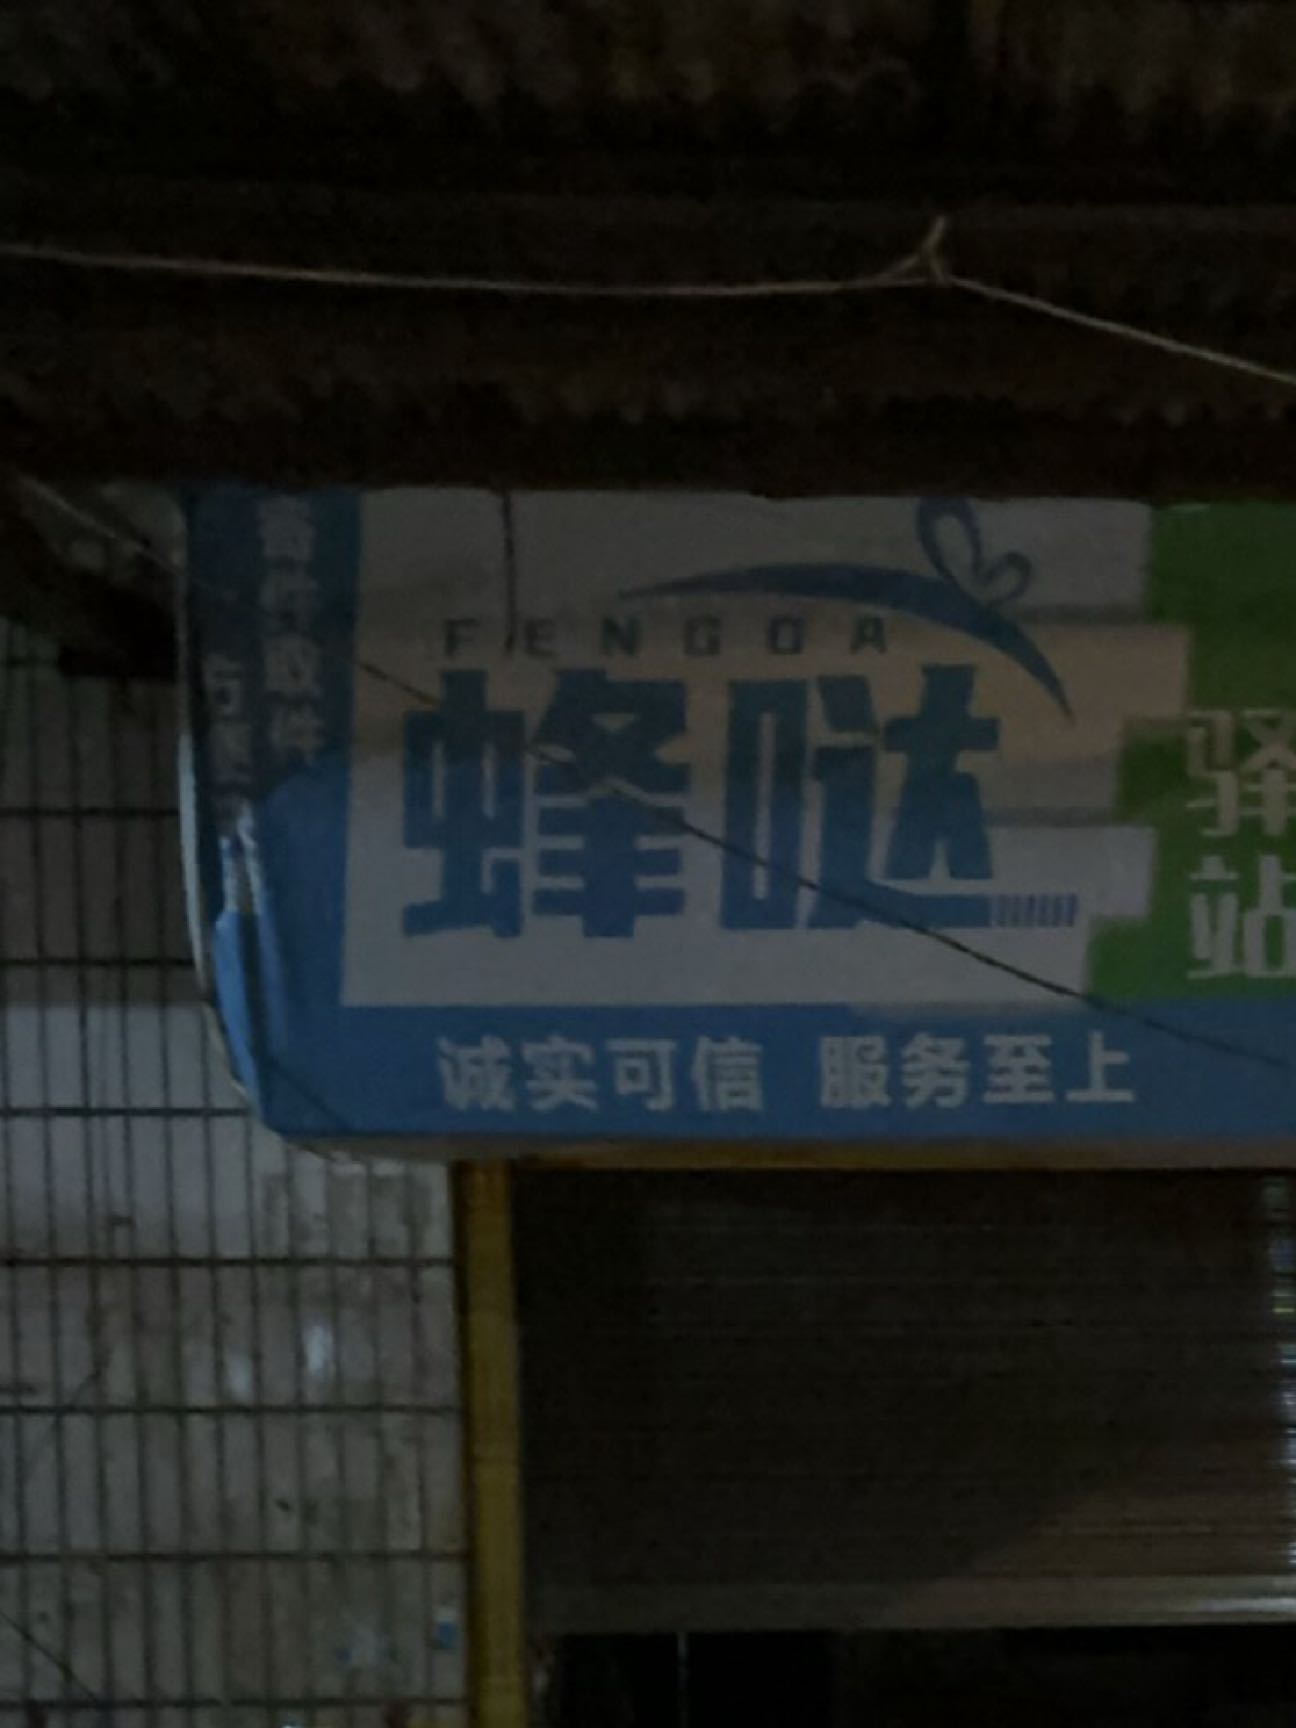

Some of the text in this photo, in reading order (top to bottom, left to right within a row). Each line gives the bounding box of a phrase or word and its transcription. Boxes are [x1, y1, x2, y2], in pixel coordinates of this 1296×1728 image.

[442, 614, 888, 657] FENGDA
[403, 665, 1000, 939] 蜂哒
[435, 1031, 1135, 1112] 诚实可信 服务至上
